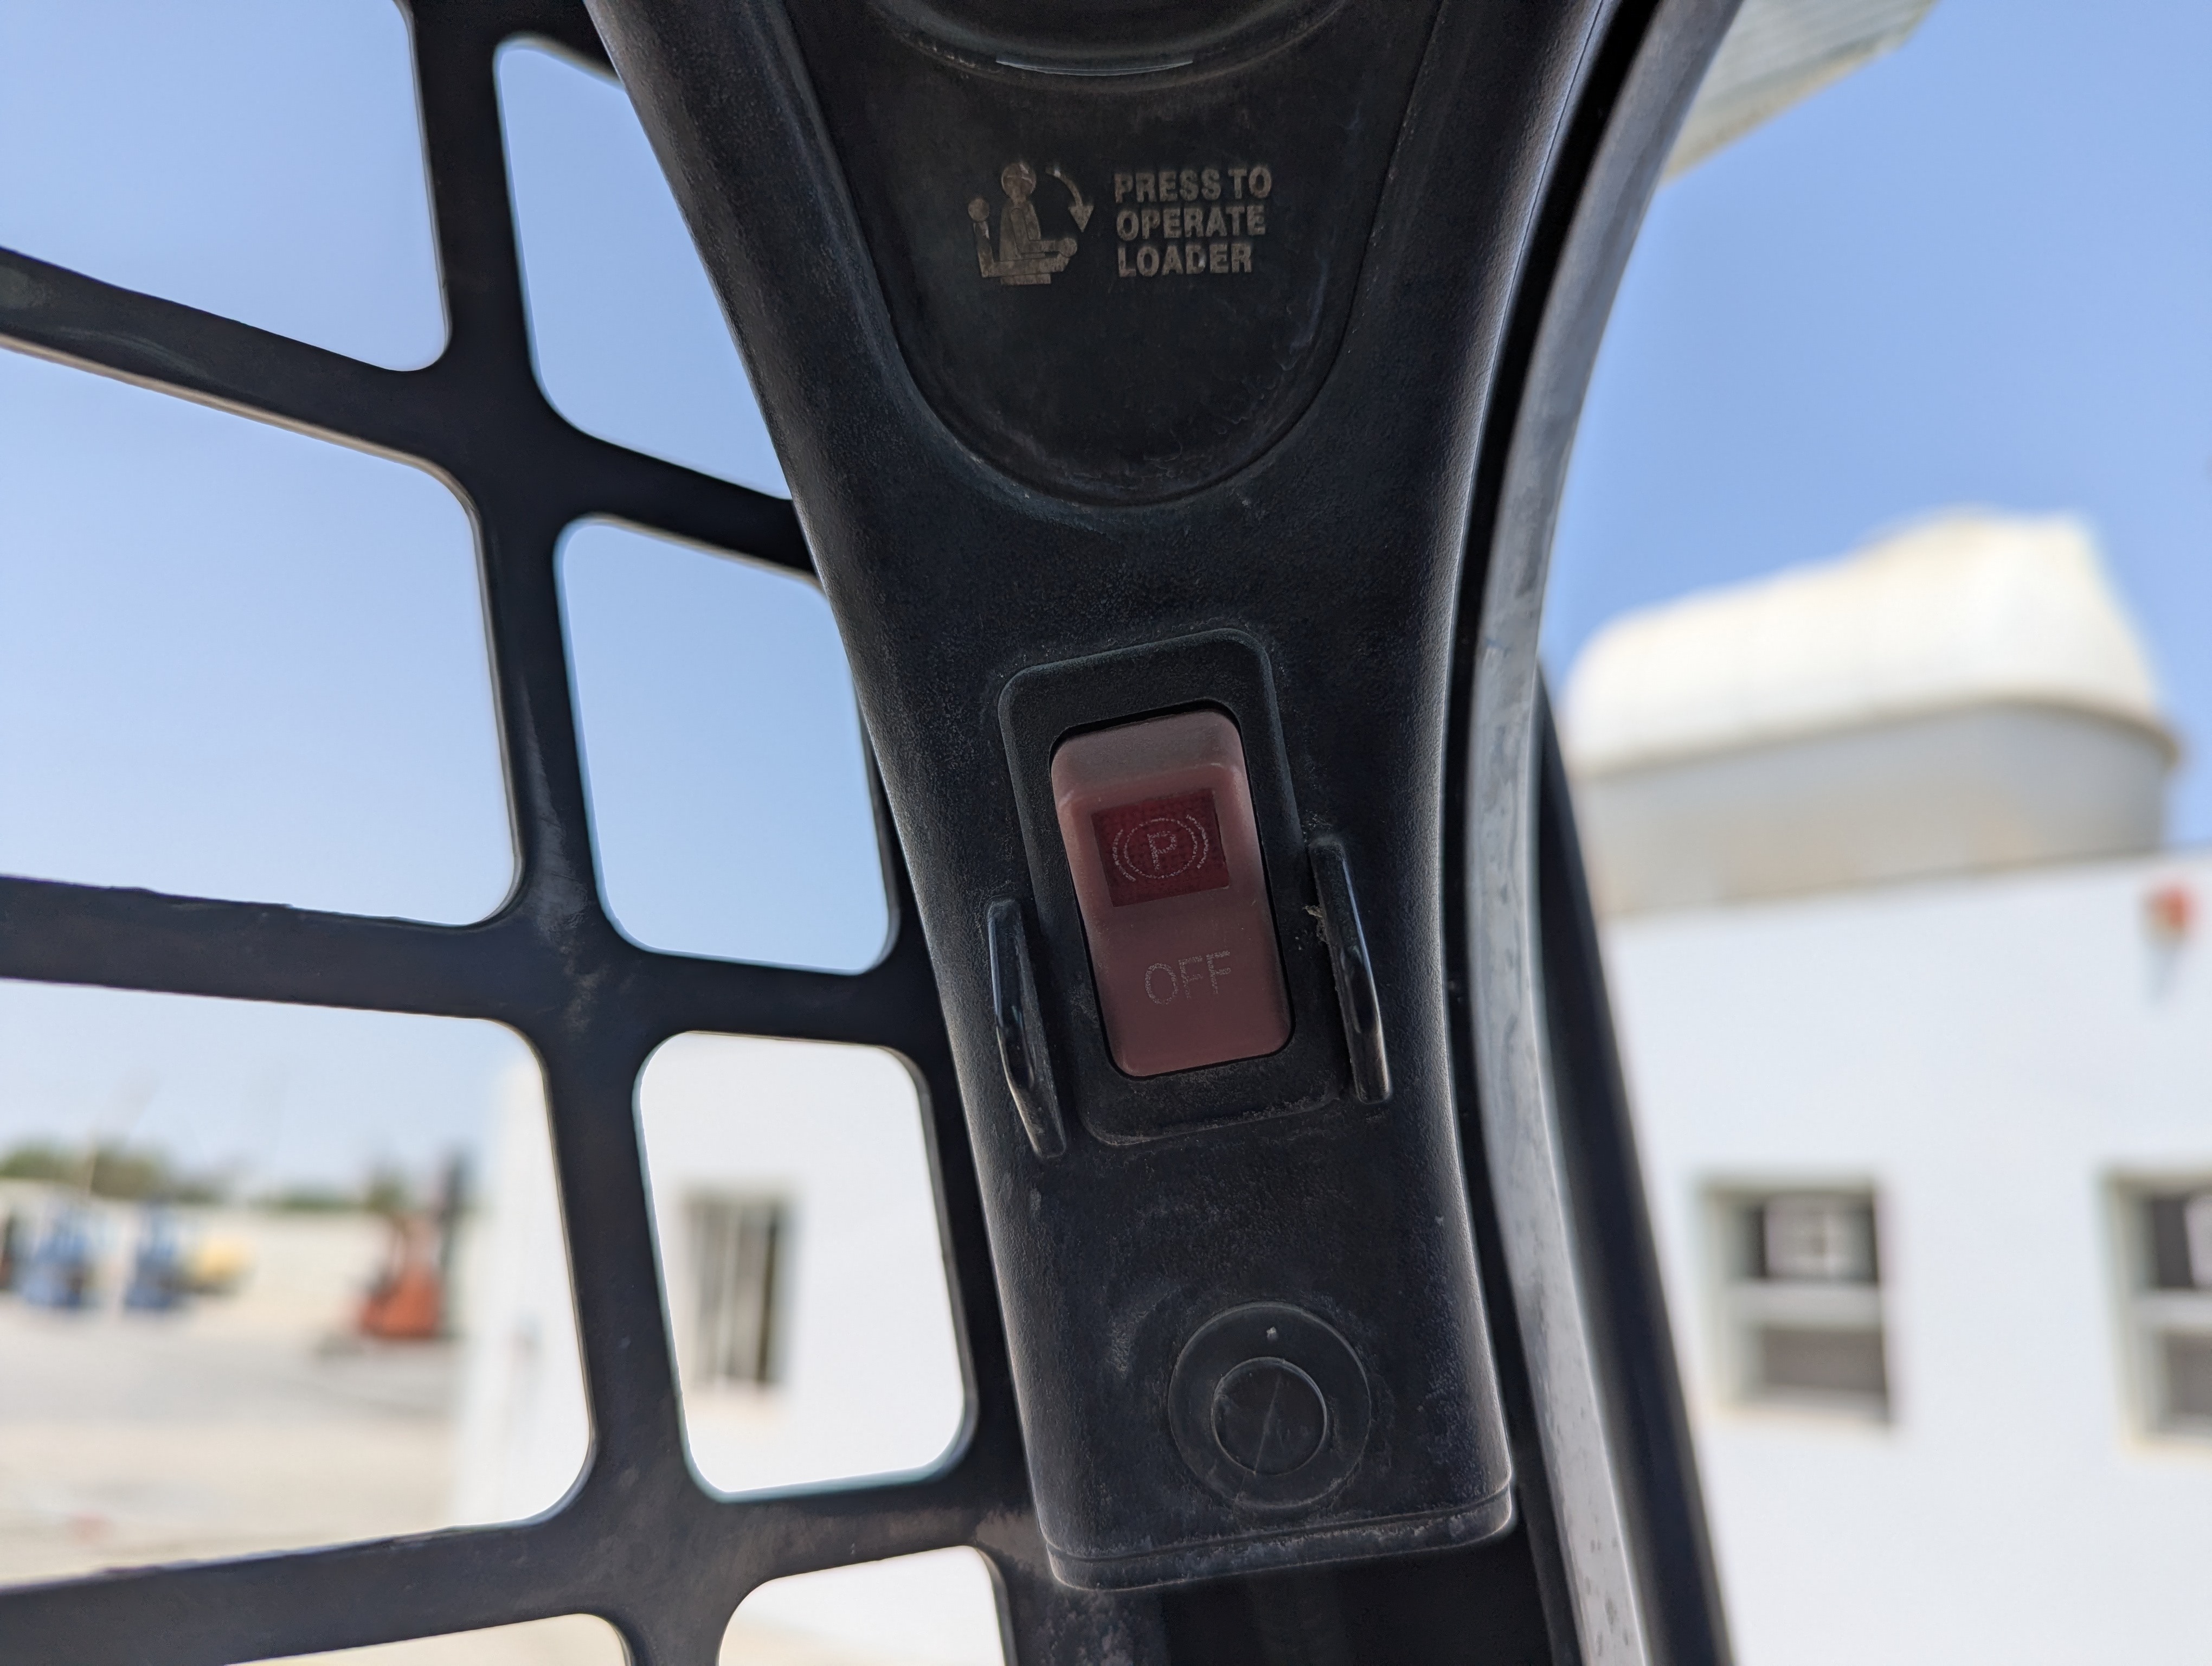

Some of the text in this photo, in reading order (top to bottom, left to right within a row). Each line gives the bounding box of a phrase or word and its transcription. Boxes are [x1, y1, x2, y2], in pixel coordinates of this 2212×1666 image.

[1114, 166, 1272, 203] PRESS TO
[1116, 205, 1265, 241] OPERATE
[1117, 244, 1252, 277] LOADER
[1147, 830, 1178, 870] P
[1145, 950, 1232, 1005] OFF
